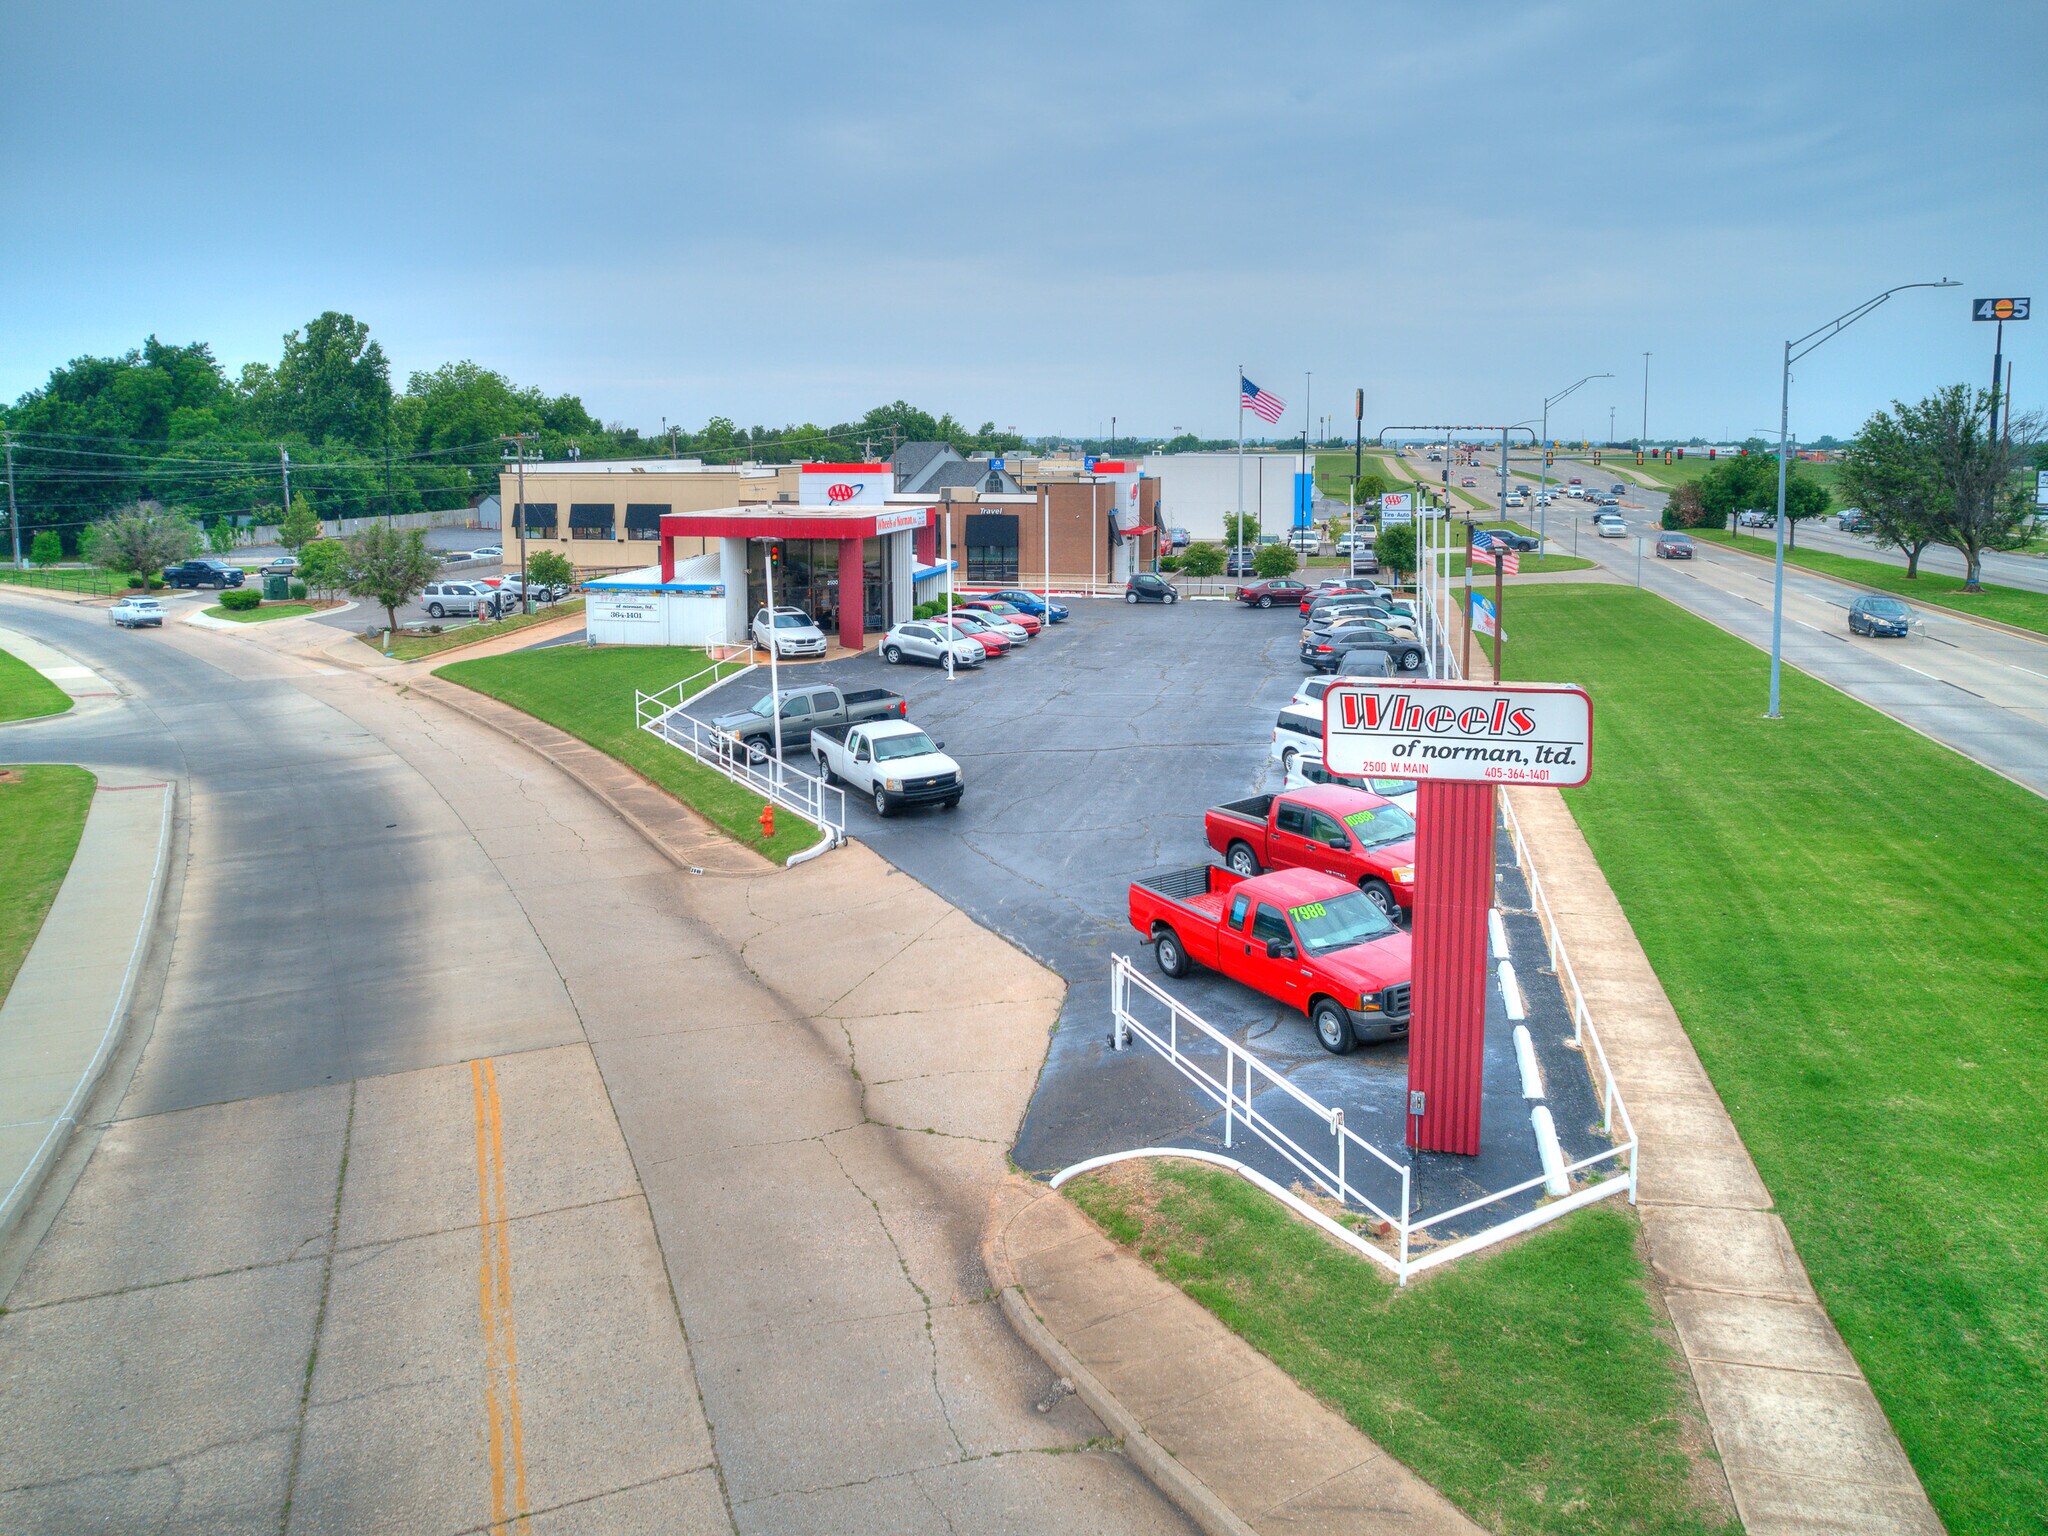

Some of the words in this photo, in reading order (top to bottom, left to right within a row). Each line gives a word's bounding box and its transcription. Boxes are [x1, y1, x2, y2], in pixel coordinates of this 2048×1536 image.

[829, 484, 853, 501] AAA
[1385, 495, 1401, 505] AAA
[878, 516, 893, 529] Wheels
[1340, 692, 1536, 737] Wheels
[1392, 739, 1421, 758] of
[1422, 745, 1529, 767] norman,
[1536, 745, 1576, 766] ltd.
[1363, 761, 1387, 773] 2500
[1390, 762, 1402, 773] W.
[1403, 763, 1429, 774] MAIN
[1485, 767, 1550, 781] 405-364-1401
[1288, 902, 1327, 923] 7988
